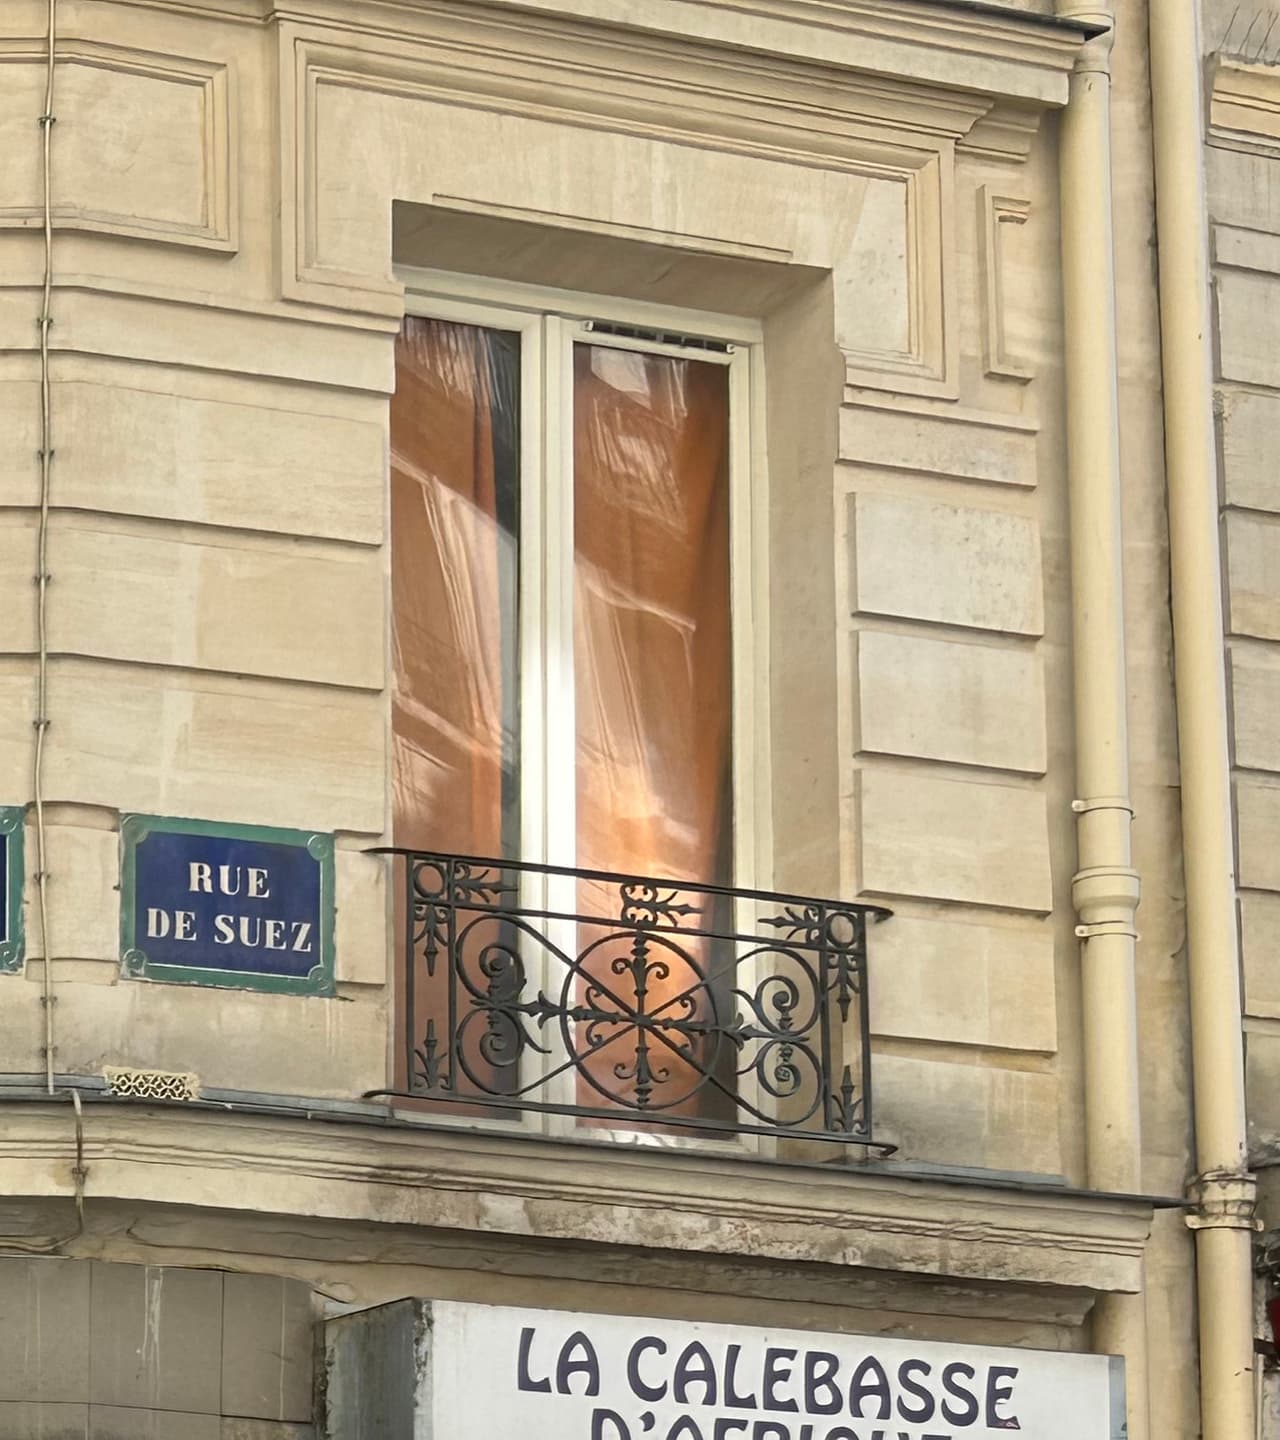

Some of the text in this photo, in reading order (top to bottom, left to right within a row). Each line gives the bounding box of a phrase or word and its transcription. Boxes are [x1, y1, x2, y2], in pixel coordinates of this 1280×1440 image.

[190, 863, 269, 898] RUE
[148, 908, 311, 952] DE SUEZ
[518, 1328, 1020, 1429] LA CALEBASSE
